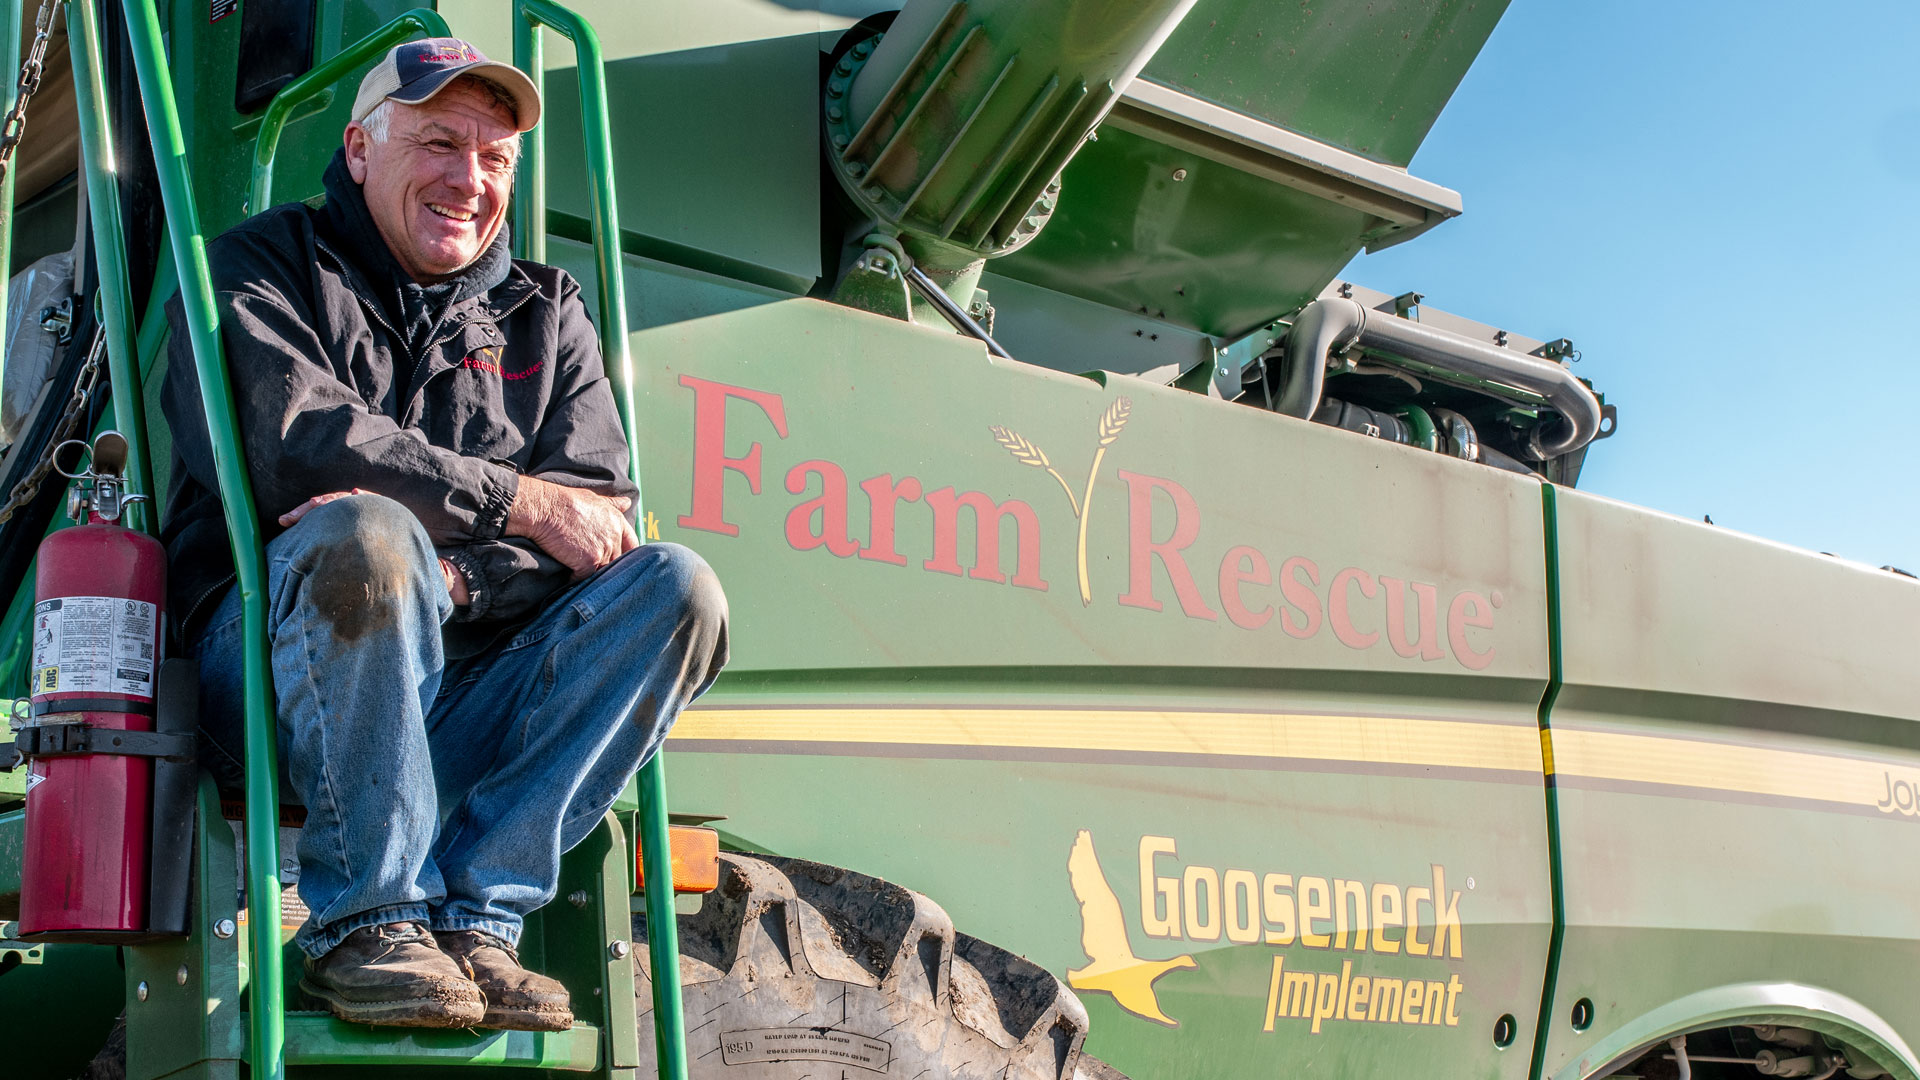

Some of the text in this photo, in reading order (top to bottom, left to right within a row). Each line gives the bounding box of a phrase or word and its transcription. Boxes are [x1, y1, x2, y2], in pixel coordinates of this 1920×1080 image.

[464, 357, 496, 374] Farm
[677, 374, 1498, 672] Farm Rescue
[46, 669, 57, 688] ABC
[1138, 835, 1464, 960] Gooseneck
[1262, 955, 1465, 1034] Implement
